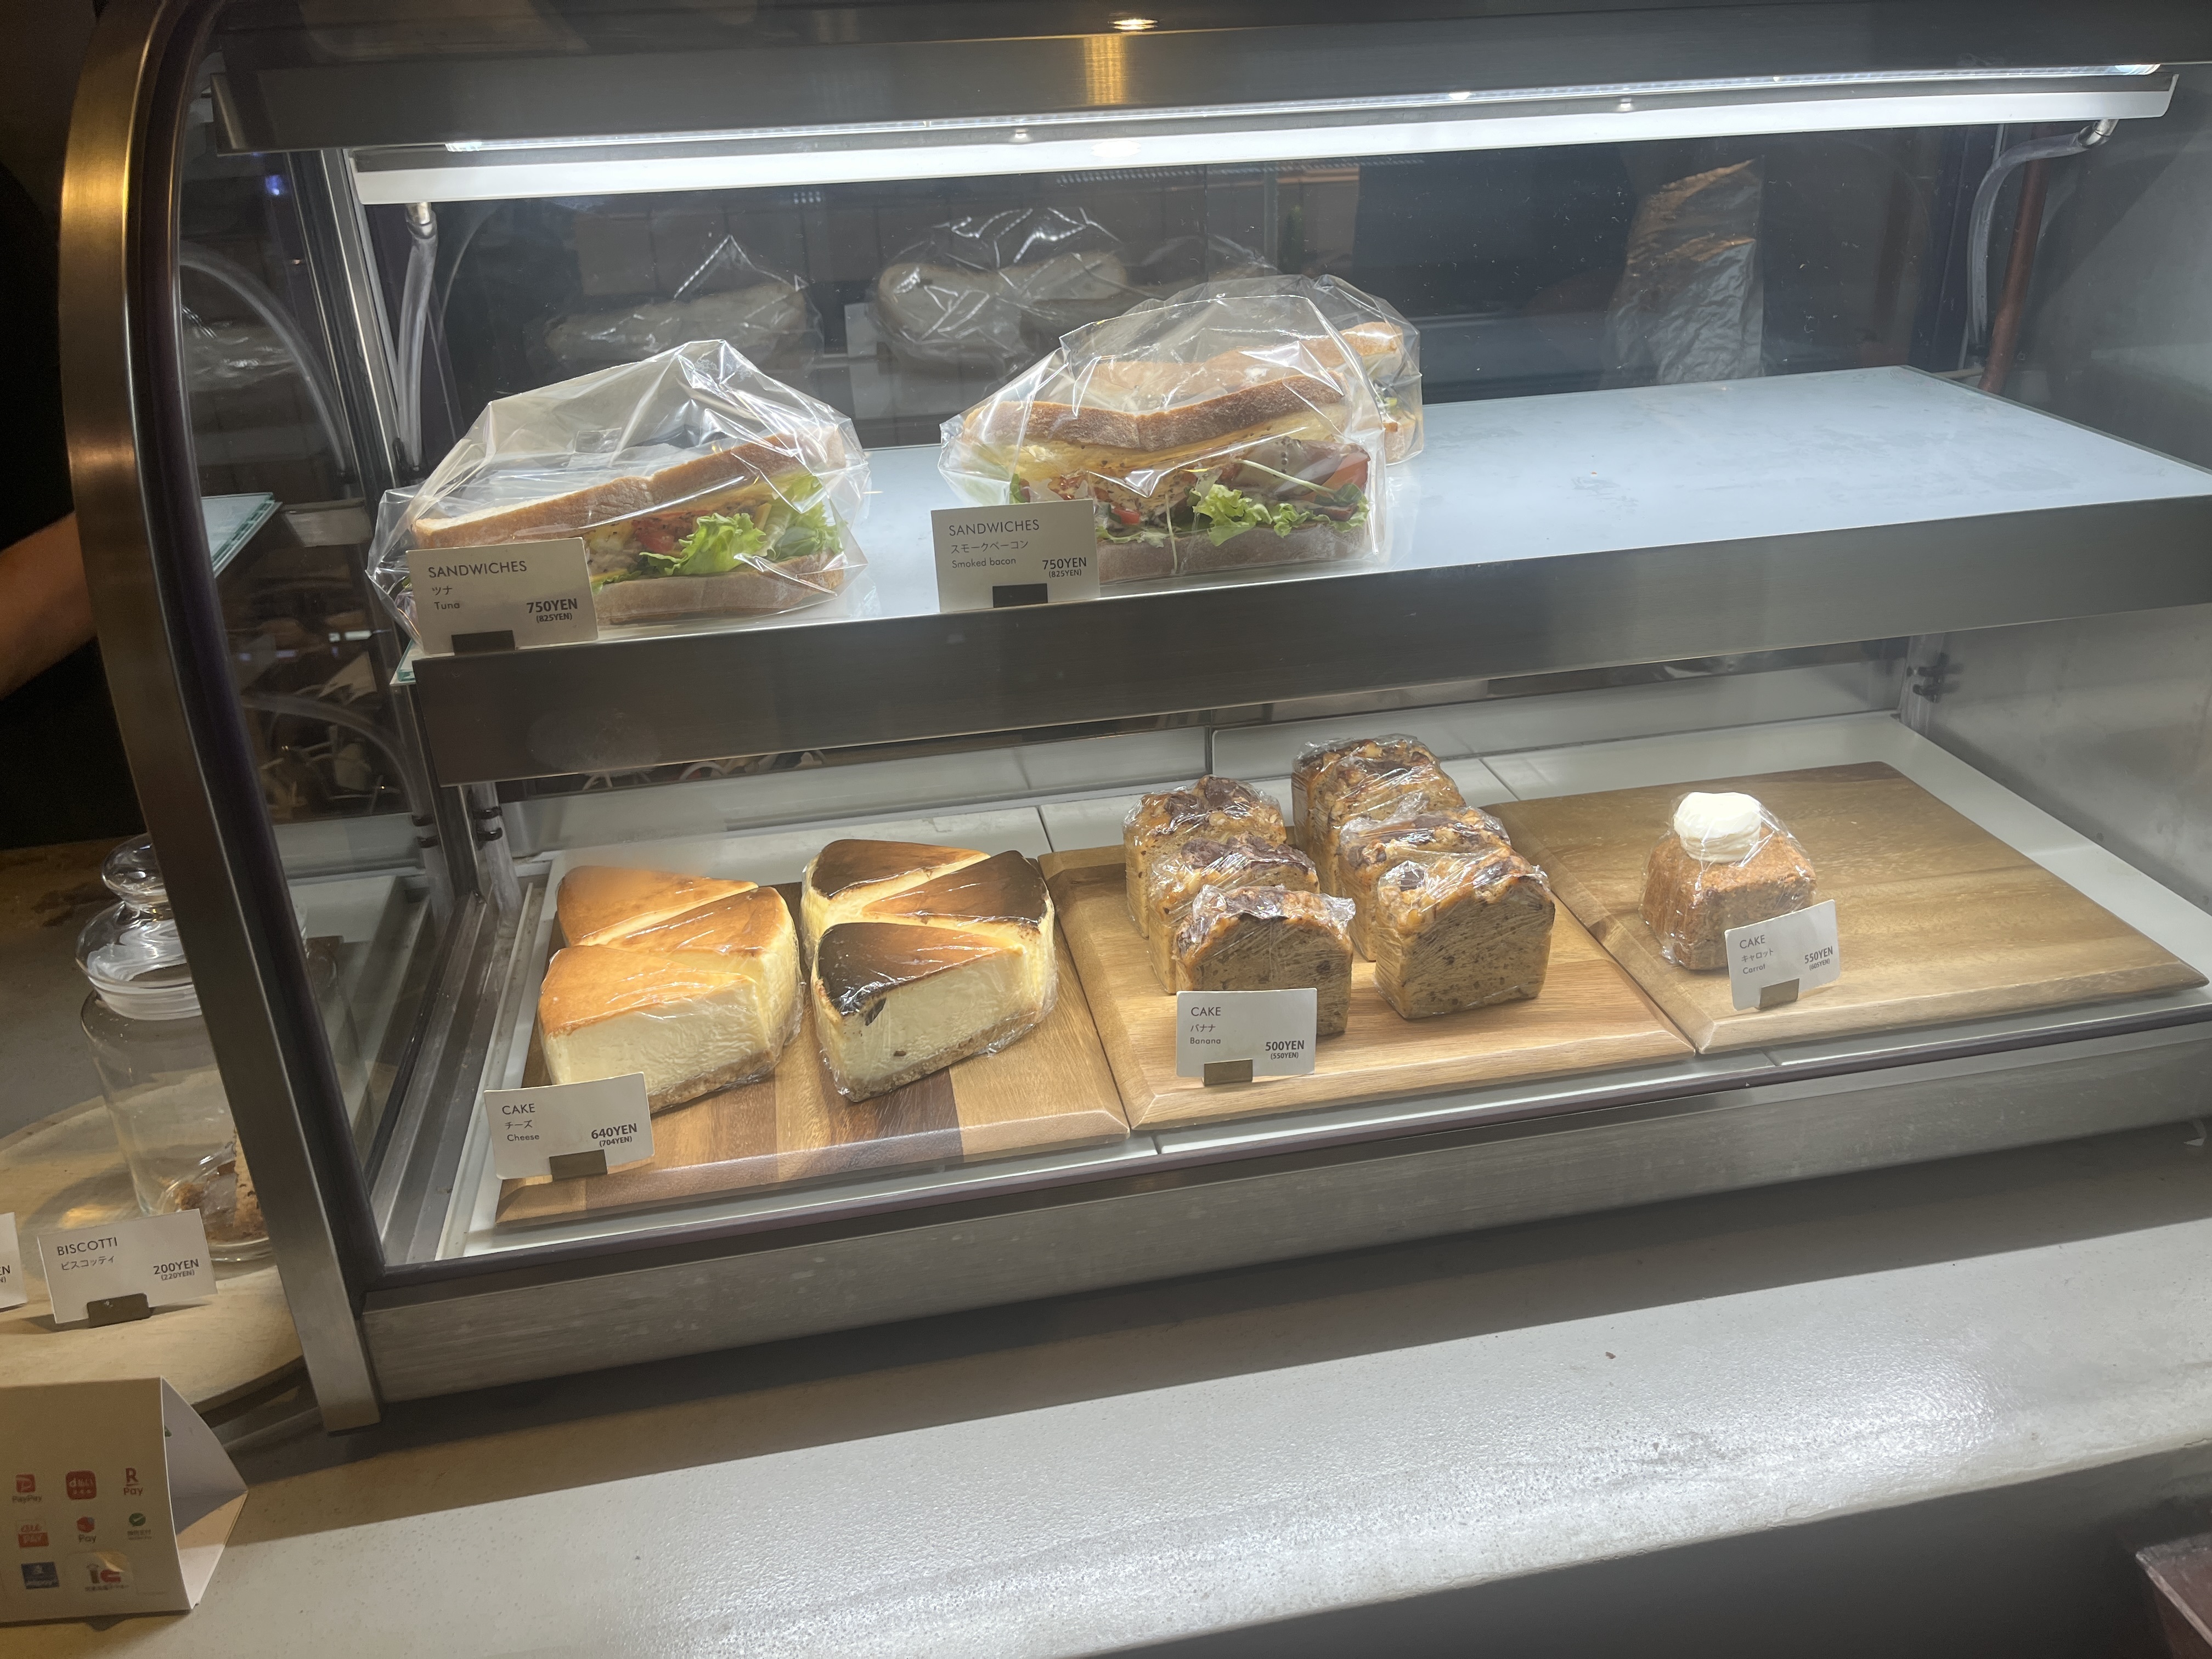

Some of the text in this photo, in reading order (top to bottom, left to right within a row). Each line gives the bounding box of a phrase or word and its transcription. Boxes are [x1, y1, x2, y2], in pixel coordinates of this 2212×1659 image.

[949, 519, 1040, 537] SANDWICHES
[951, 540, 1029, 554] スモークベーコン
[952, 557, 1016, 568] Smoked bacon
[1042, 557, 1087, 570] 750YEN
[428, 560, 527, 578] SANDWICHES
[1048, 568, 1082, 578] (825YEN)
[432, 585, 453, 596] ツナ
[434, 601, 460, 610] Tuna
[526, 598, 578, 614] 750YEN
[535, 612, 572, 623] (825YEN)
[1739, 934, 1765, 949] CAKE
[1741, 948, 1774, 962] キャロット
[1804, 945, 1833, 964] 550YEN
[1742, 963, 1765, 974] Carrot
[1190, 1007, 1221, 1017] CAKE
[1190, 1023, 1216, 1032] バナナ
[1265, 1040, 1305, 1051] 500YEN
[1271, 1052, 1299, 1060] (550YEN)
[502, 1103, 535, 1115] CAKE
[504, 1119, 533, 1130] チーズ
[591, 1123, 637, 1139] 640YEN
[507, 1133, 540, 1142] Cheese
[599, 1136, 633, 1147] (704YEN)
[57, 1237, 118, 1256] BISCOTTI
[61, 1255, 115, 1271] ビスコッティ
[153, 1259, 200, 1275] 200YEN
[161, 1269, 195, 1281] (220YEN)
[123, 1487, 143, 1496] Pay
[12, 1494, 42, 1504] PayPay
[78, 1534, 97, 1543] Pay
